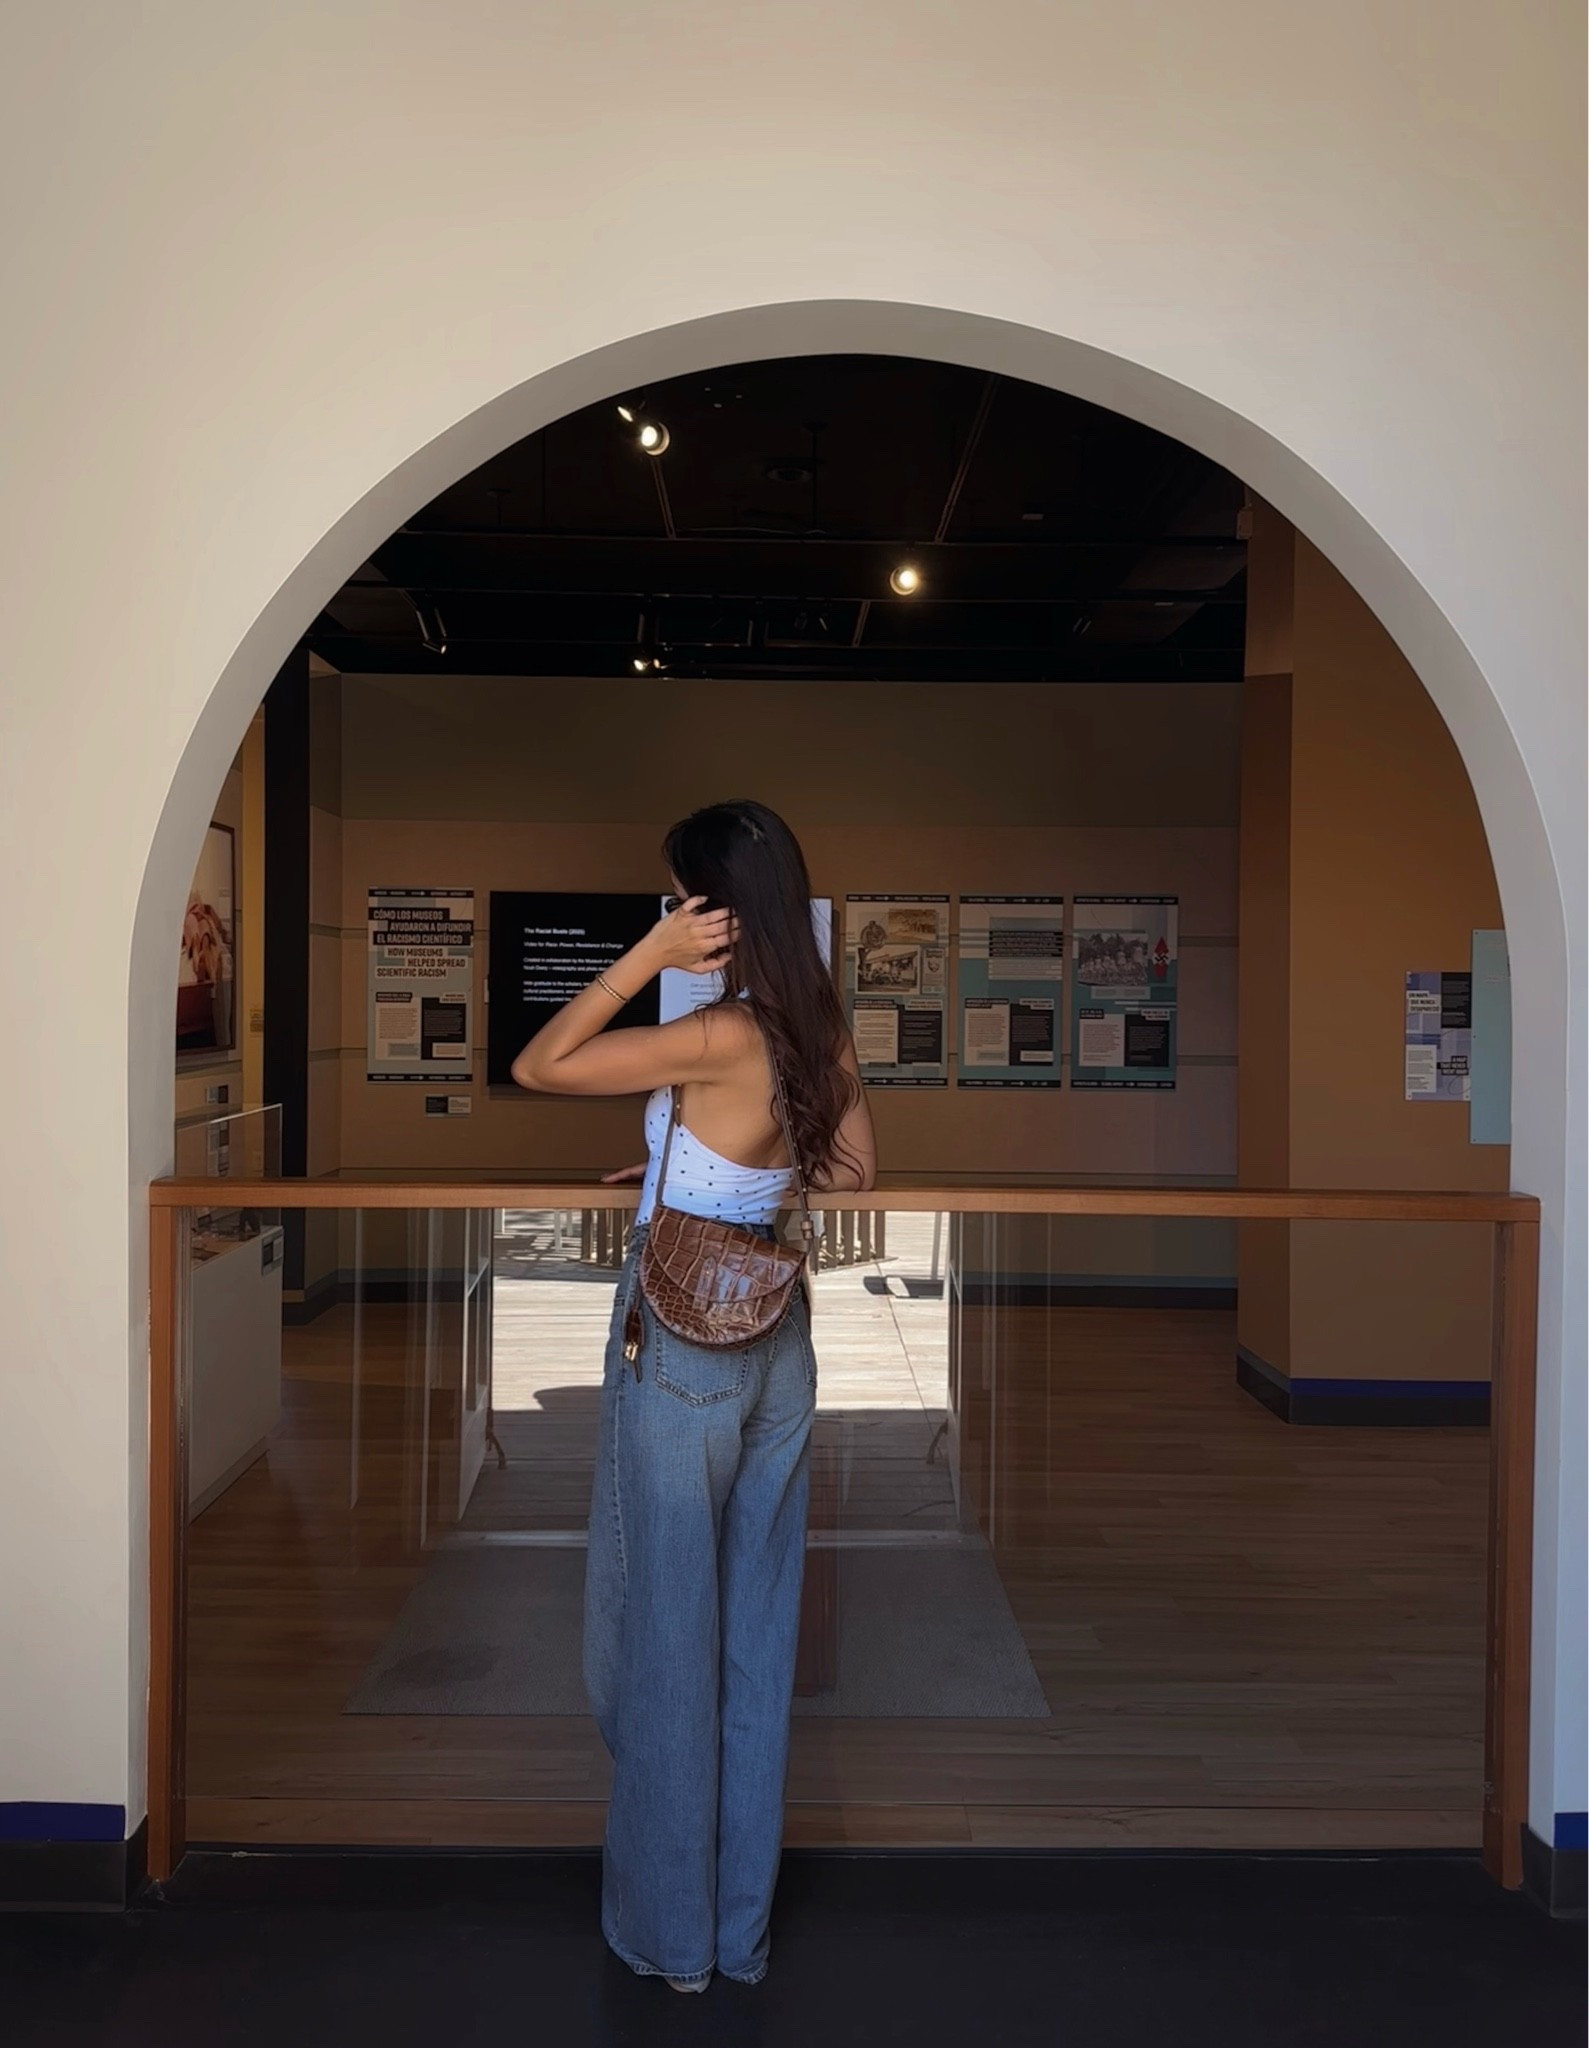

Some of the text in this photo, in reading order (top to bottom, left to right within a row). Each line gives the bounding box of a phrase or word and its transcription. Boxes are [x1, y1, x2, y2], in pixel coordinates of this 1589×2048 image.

[373, 909, 443, 920] CÓMO LOS MUSEOS
[390, 922, 472, 932] AYUDARON A DIFUNDIR
[377, 933, 463, 944] EL RACISMO CIENTÍFICO
[387, 948, 443, 957] HOW MUSEUMS
[407, 958, 466, 968] HELPED SPREAD
[377, 968, 446, 977] SCIENTIFIC RACISM
